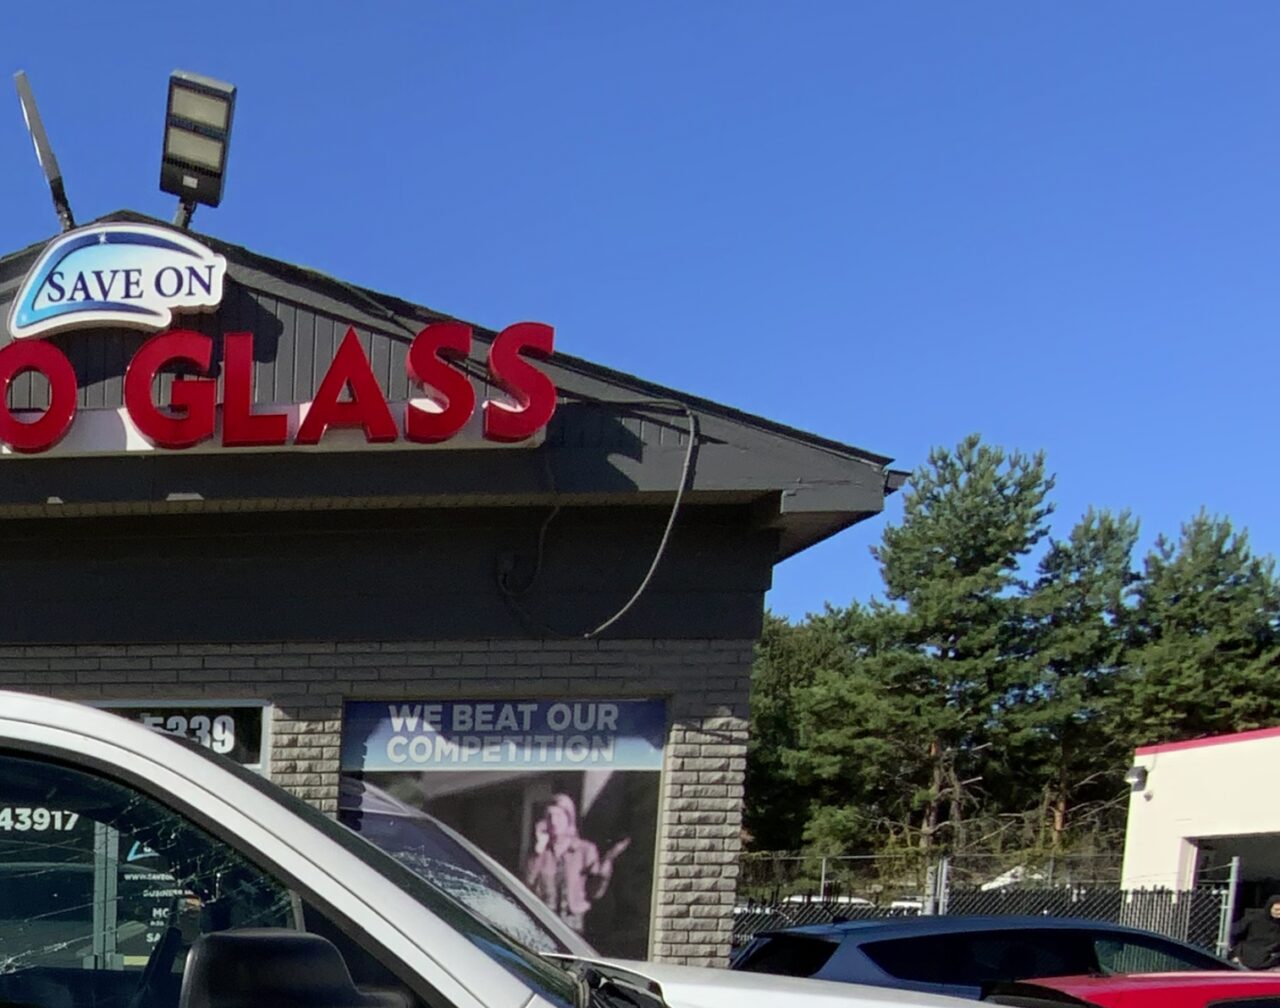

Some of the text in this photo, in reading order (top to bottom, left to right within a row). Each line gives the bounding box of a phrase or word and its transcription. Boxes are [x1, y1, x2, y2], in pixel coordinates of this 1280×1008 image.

[47, 265, 215, 302] SAVE ON
[123, 322, 557, 449] GLASS
[388, 703, 619, 732] WE BEAT OUR
[386, 735, 616, 763] COMPETITION
